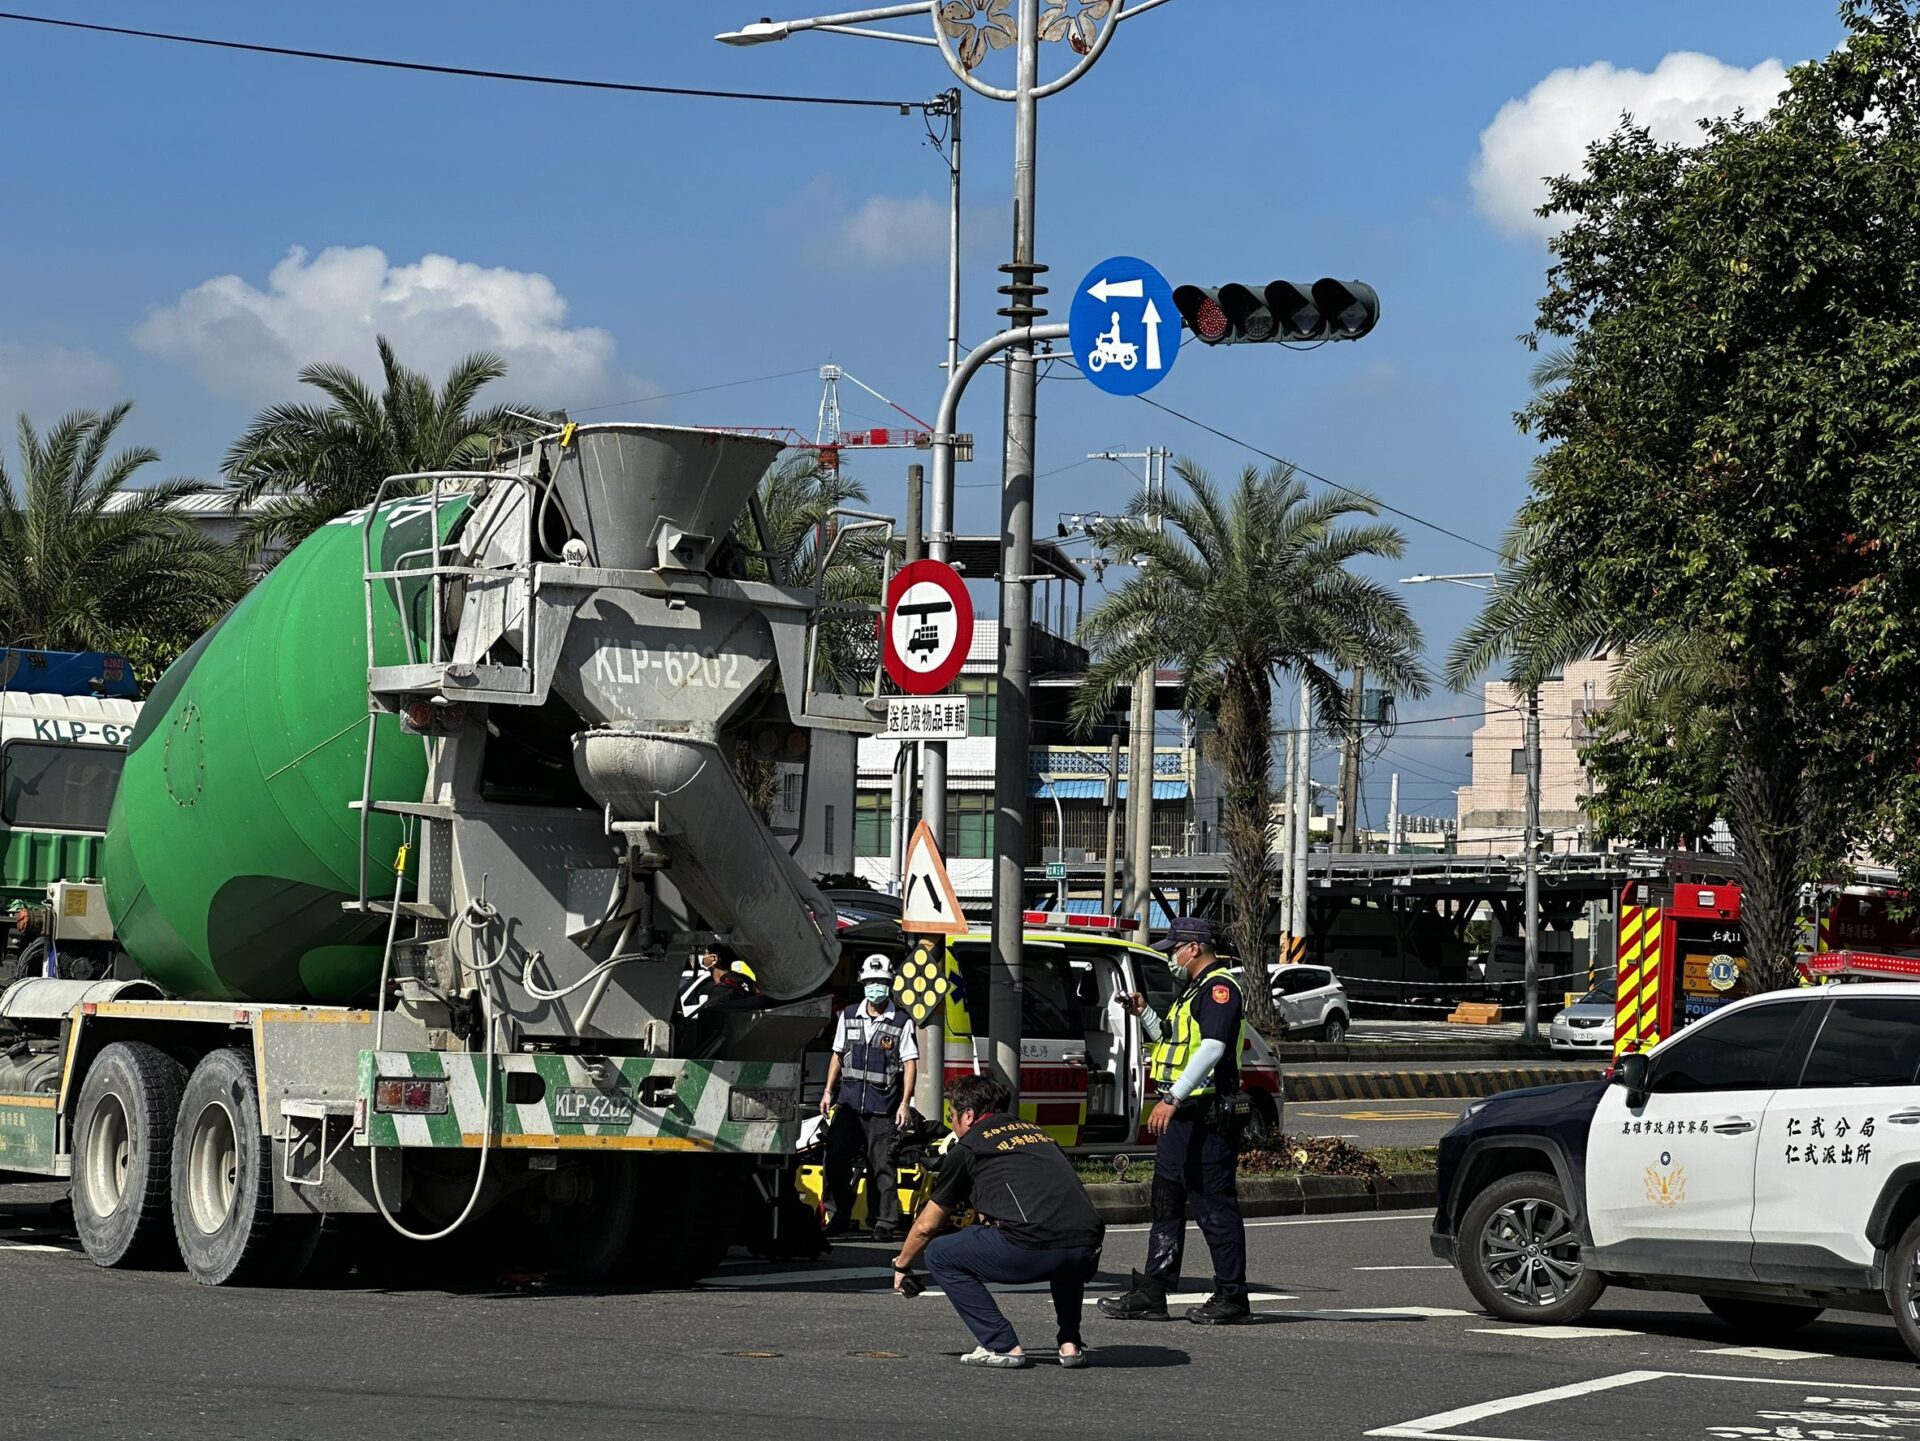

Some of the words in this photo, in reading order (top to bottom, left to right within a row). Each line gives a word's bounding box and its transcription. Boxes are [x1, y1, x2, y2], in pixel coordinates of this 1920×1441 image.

[593, 636, 742, 689] KLP-6202
[1713, 954, 1735, 965] LIONS
[1718, 965, 1728, 979] L
[555, 1094, 630, 1118] KLP-6202
[1621, 1118, 1709, 1136] 高雄市政府警察局
[1786, 1115, 1876, 1139] 仁武分局
[1784, 1142, 1873, 1166] 仁武派出所
